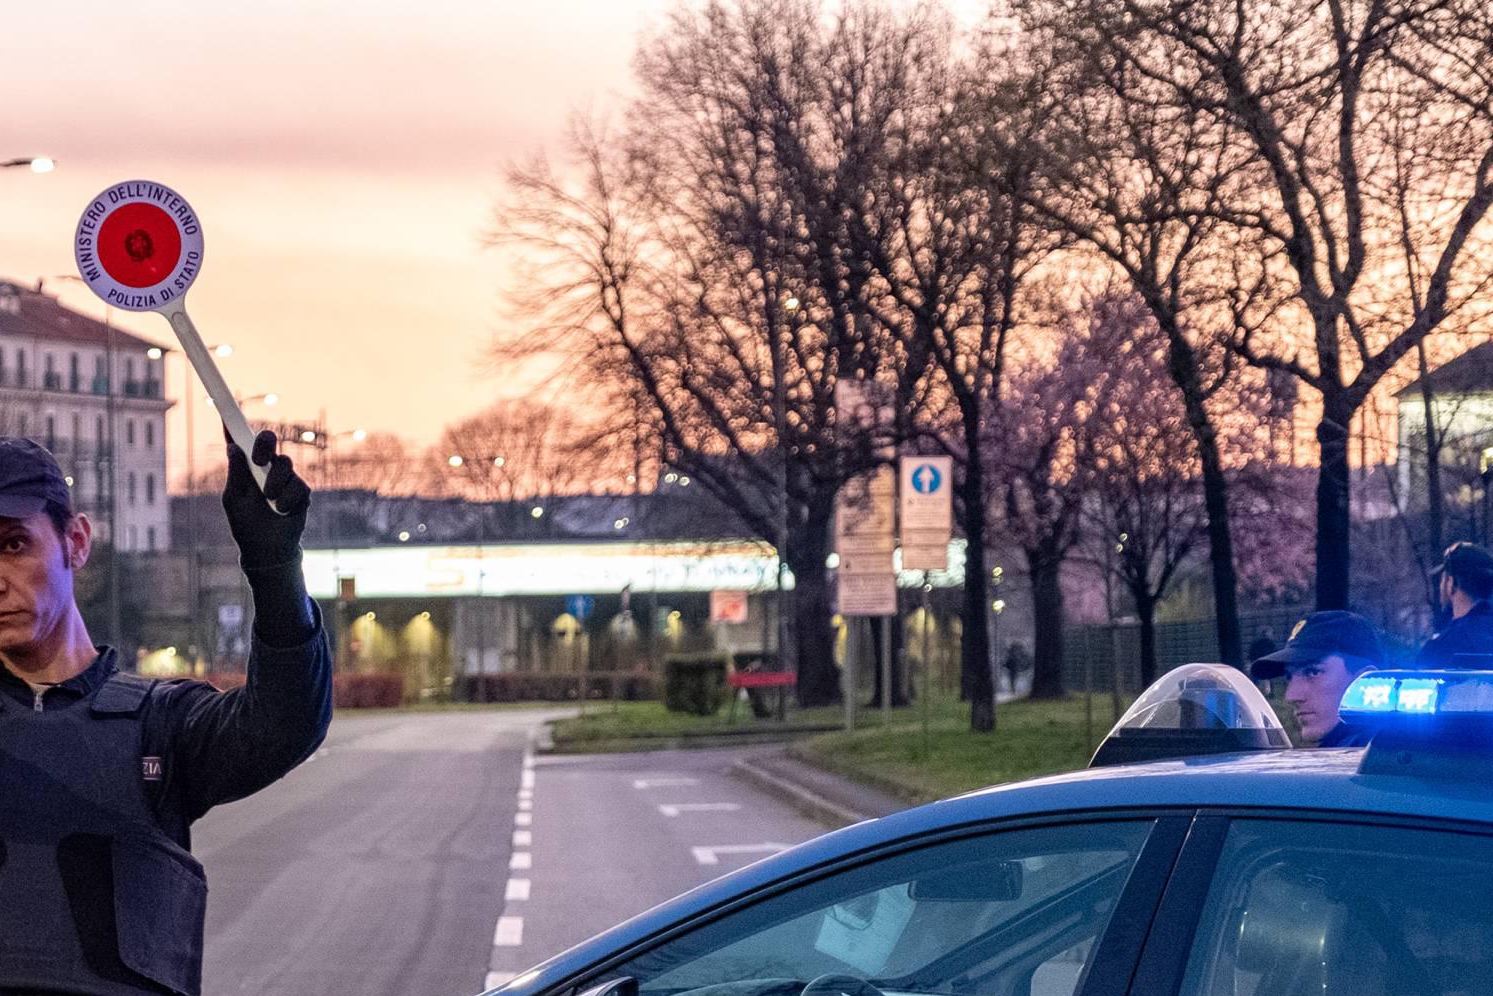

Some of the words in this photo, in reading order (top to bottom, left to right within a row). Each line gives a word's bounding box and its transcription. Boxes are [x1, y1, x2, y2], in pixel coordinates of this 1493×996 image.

[78, 201, 106, 282] MINISTERO
[108, 183, 198, 236] DELL'INTERNO
[108, 288, 157, 308] POLIZIA
[160, 287, 174, 301] DI
[174, 250, 200, 289] STATO
